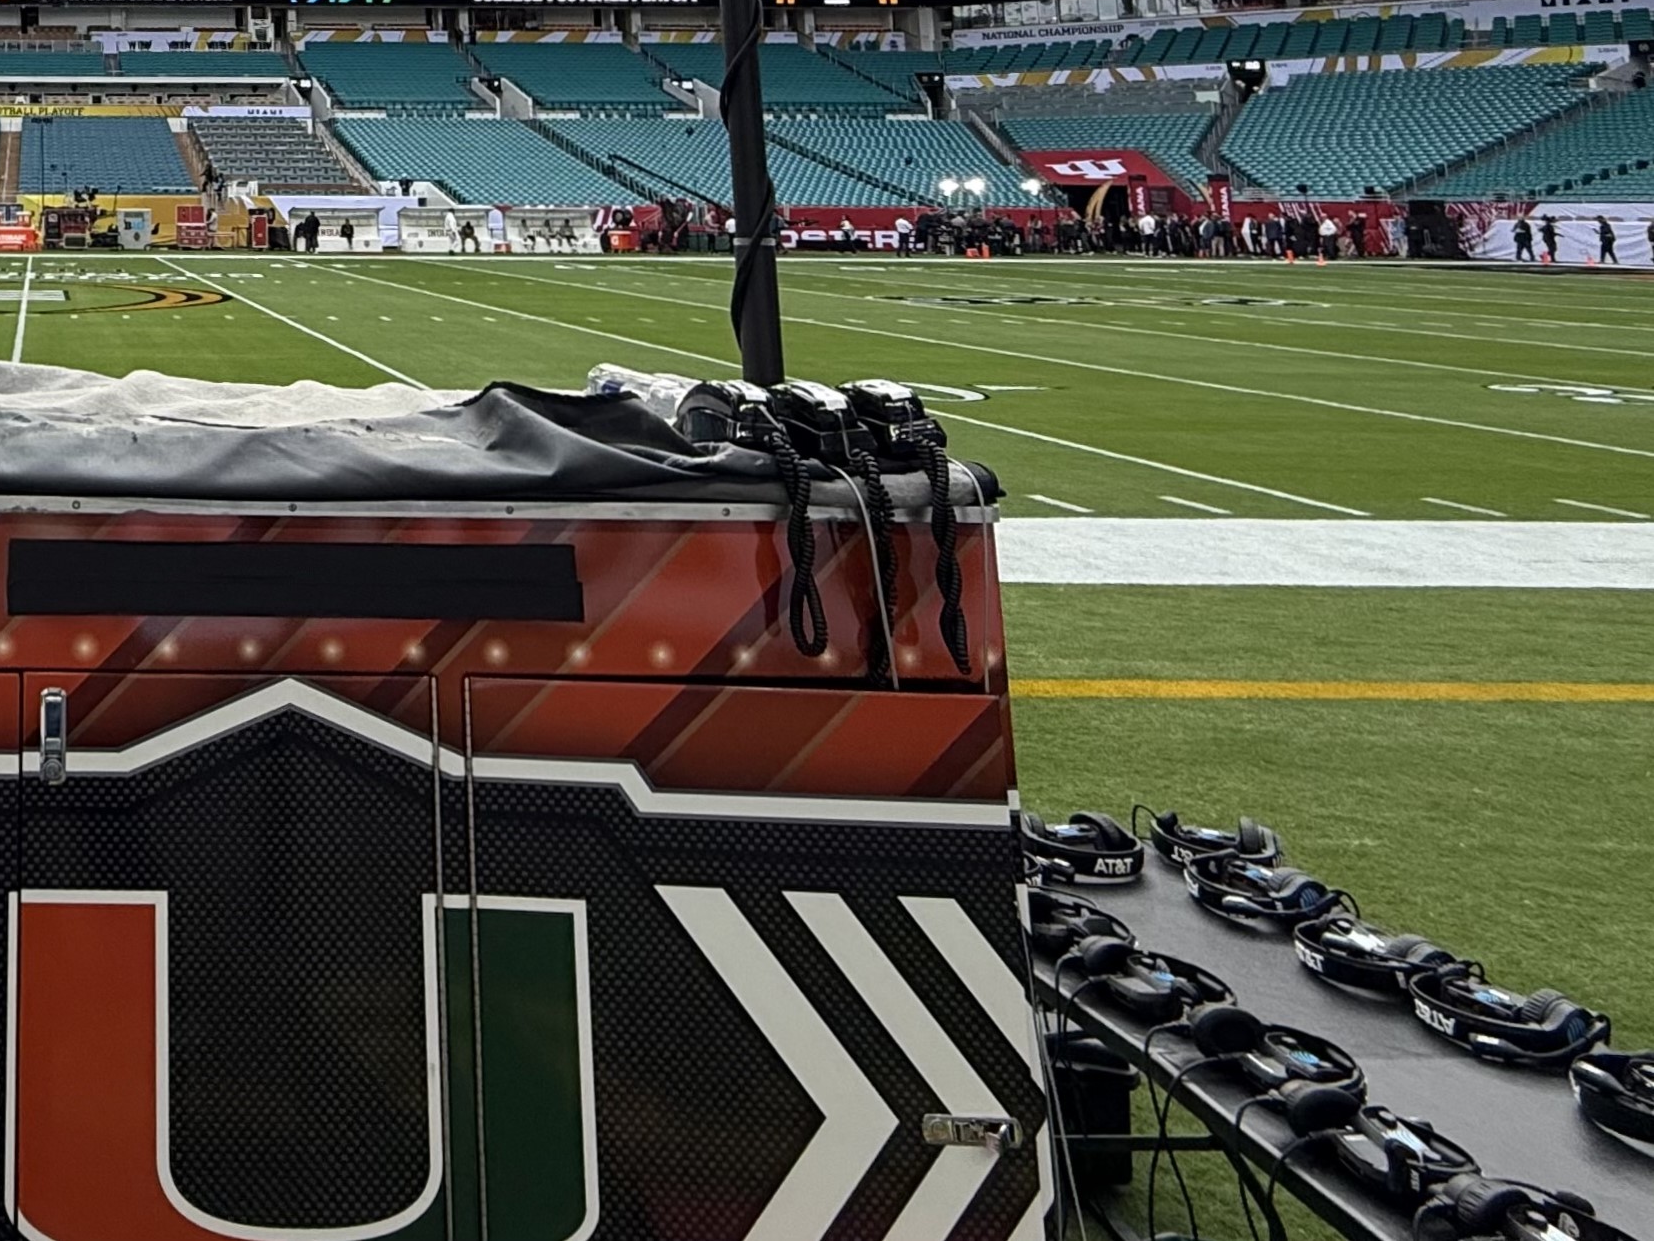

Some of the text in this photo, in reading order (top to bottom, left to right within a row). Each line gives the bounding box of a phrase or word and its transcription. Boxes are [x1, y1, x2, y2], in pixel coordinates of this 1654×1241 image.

[981, 23, 1125, 42] NATIONAL CHAMPIONSHIP
[38, 105, 86, 118] PLAYOFF
[1094, 857, 1134, 876] AT&T
[5, 887, 601, 1241] U
